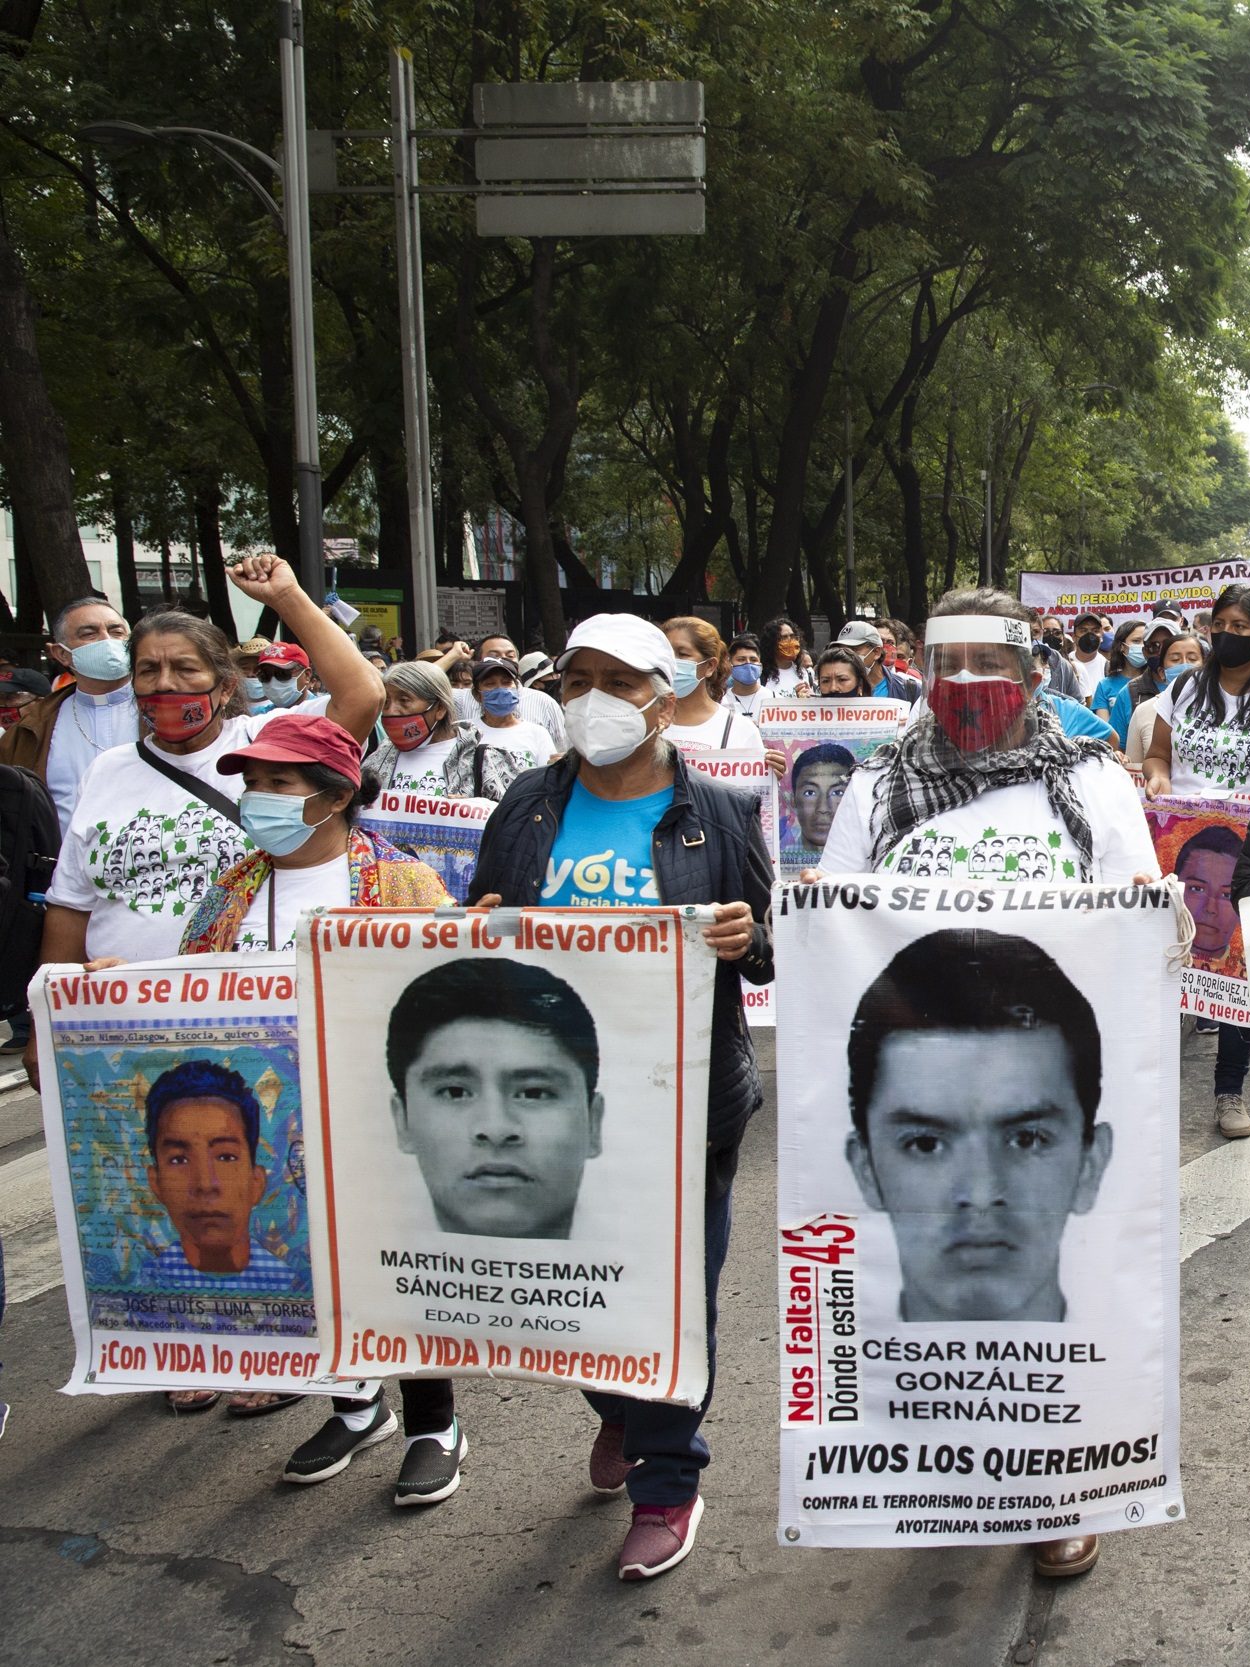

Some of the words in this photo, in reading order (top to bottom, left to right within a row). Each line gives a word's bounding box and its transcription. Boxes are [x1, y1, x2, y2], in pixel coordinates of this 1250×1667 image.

[1118, 568, 1204, 588] JUSTICIA
[1080, 589, 1138, 604] PERDÓN
[1141, 590, 1157, 603] NI
[1160, 586, 1216, 600] OLVIDO,
[1047, 604, 1079, 615] AÑOS
[760, 707, 798, 723] ¡Vivo
[801, 708, 815, 722] se
[820, 708, 833, 721] lo
[837, 707, 898, 722] llevaron!
[381, 792, 400, 811] lo
[404, 794, 491, 820] llevaron!
[541, 849, 660, 899] yotz
[570, 894, 611, 907] hacia
[780, 884, 881, 916] ¡VIVOS
[888, 886, 929, 911] SE
[936, 888, 994, 912] LOS
[1002, 885, 1171, 911] LLEVARON!
[323, 918, 411, 952] ¡Vivo
[422, 922, 458, 949] se
[471, 919, 502, 950] lo
[49, 973, 128, 1010] ¡Vivo
[137, 977, 172, 1003] se
[180, 973, 209, 1003] lo
[217, 971, 298, 1002] lleva
[1189, 984, 1201, 995] Luz
[1196, 974, 1241, 996] RODRÍGUEZ
[1194, 994, 1205, 1012] lo
[59, 1034, 75, 1046] Yo,
[79, 1033, 95, 1043] Jan
[175, 1031, 218, 1042] Escocia,
[224, 1029, 259, 1041] quiero
[264, 1029, 293, 1039] saber
[380, 1250, 464, 1274] MARTÍN
[471, 1258, 624, 1283] GETSEMANY
[395, 1275, 504, 1304] SÁNCHEZ
[510, 1286, 607, 1309] GARCÍA
[824, 1269, 856, 1337] están
[122, 1296, 158, 1313] JOSÉ
[215, 1301, 254, 1317] LUNA
[262, 1302, 317, 1320] TORRES
[425, 1309, 481, 1325] EDAD
[488, 1315, 513, 1329] 20
[520, 1315, 581, 1333] AÑOS
[784, 1265, 814, 1355] faltan
[99, 1318, 120, 1329] Hijo
[123, 1320, 133, 1328] de
[138, 1320, 186, 1330] Macedonia
[201, 1322, 212, 1330] 20
[216, 1322, 238, 1331] años
[99, 1340, 146, 1374] ¡Con
[153, 1341, 206, 1373] VIDA
[212, 1344, 234, 1375] lo
[239, 1349, 320, 1381] querem
[350, 1328, 407, 1366] ¡Con
[415, 1333, 480, 1369] VIDA
[485, 1339, 511, 1369] lo
[519, 1346, 661, 1387] queremos!
[862, 1337, 966, 1362] CÉSAR
[975, 1341, 1107, 1363] MANUEL
[786, 1367, 815, 1422] Nos
[826, 1344, 859, 1422] Dónde
[895, 1368, 1065, 1394] GONZÁLEZ
[888, 1397, 1082, 1424] HERNÁNDEZ
[805, 1443, 909, 1481] ¡VIVOS
[917, 1444, 975, 1475] LOS
[983, 1434, 1159, 1482] QUEREMOS!
[802, 1496, 859, 1511] CONTRA
[862, 1495, 878, 1510] EL
[882, 1494, 973, 1510] TERRORISMO
[976, 1496, 996, 1511] DE
[998, 1495, 1056, 1512] ESTADO,
[1059, 1492, 1077, 1507] LA
[1079, 1474, 1168, 1503] SOLIDARIDAD
[895, 1518, 980, 1535] AYOTZINAPA
[983, 1517, 1032, 1534] SOMXS
[1036, 1513, 1081, 1530] TODXS
